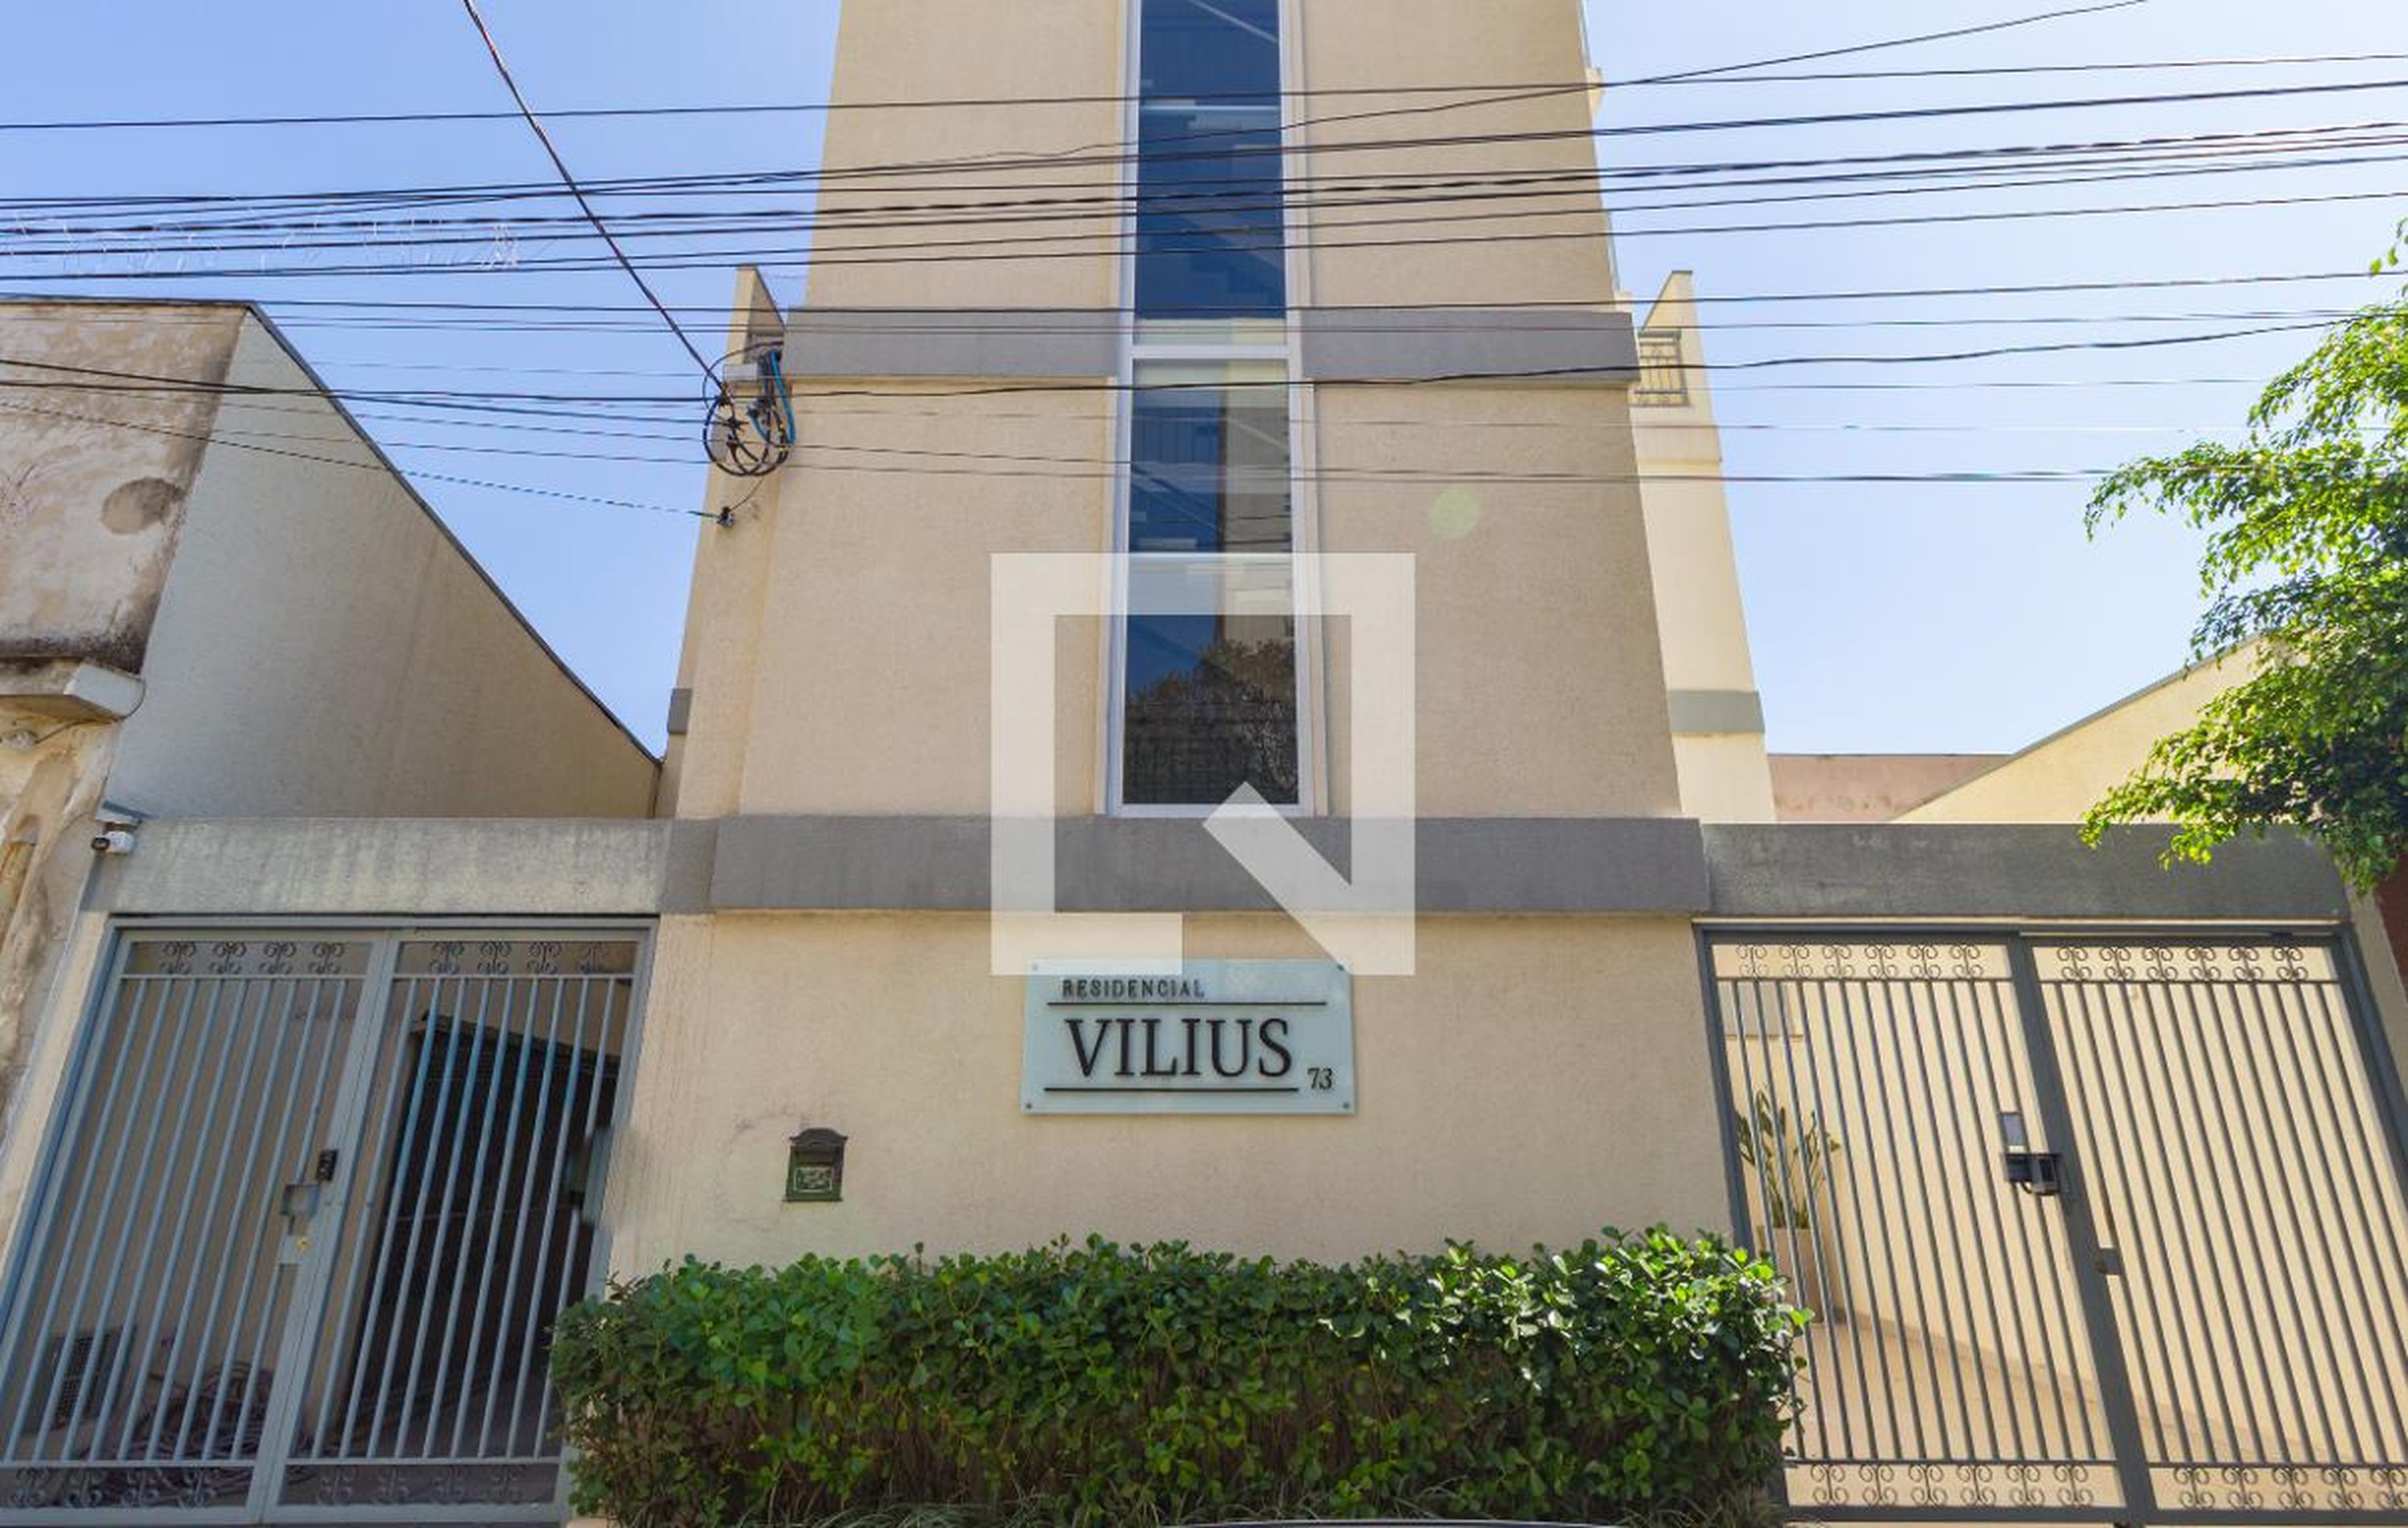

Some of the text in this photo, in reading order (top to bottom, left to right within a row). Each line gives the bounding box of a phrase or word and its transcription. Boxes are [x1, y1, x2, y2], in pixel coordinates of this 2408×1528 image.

[1062, 979, 1205, 999] RESIDENCIAL
[1064, 1018, 1293, 1078] VILIUS
[1306, 1067, 1333, 1090] 73
